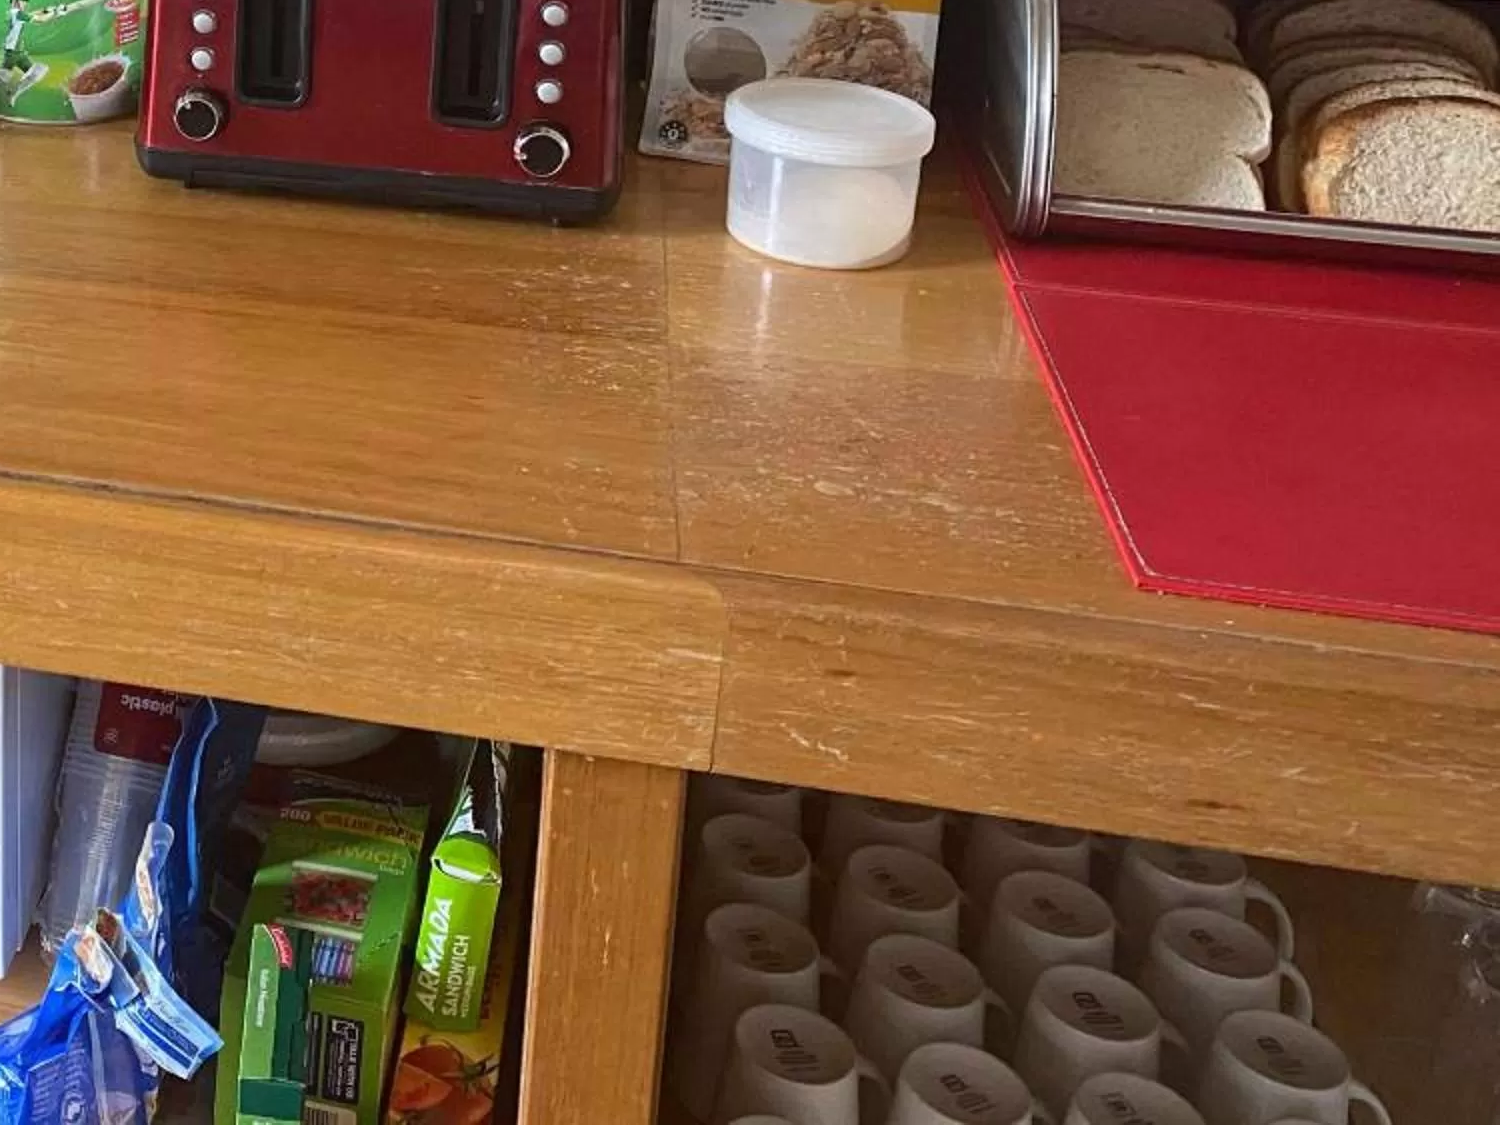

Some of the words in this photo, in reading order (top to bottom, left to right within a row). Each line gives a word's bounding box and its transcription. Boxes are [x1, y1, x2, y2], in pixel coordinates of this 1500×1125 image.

[119, 694, 175, 716] plastic
[416, 897, 452, 1014] ARMADA
[441, 934, 471, 1016] SANDWICH
